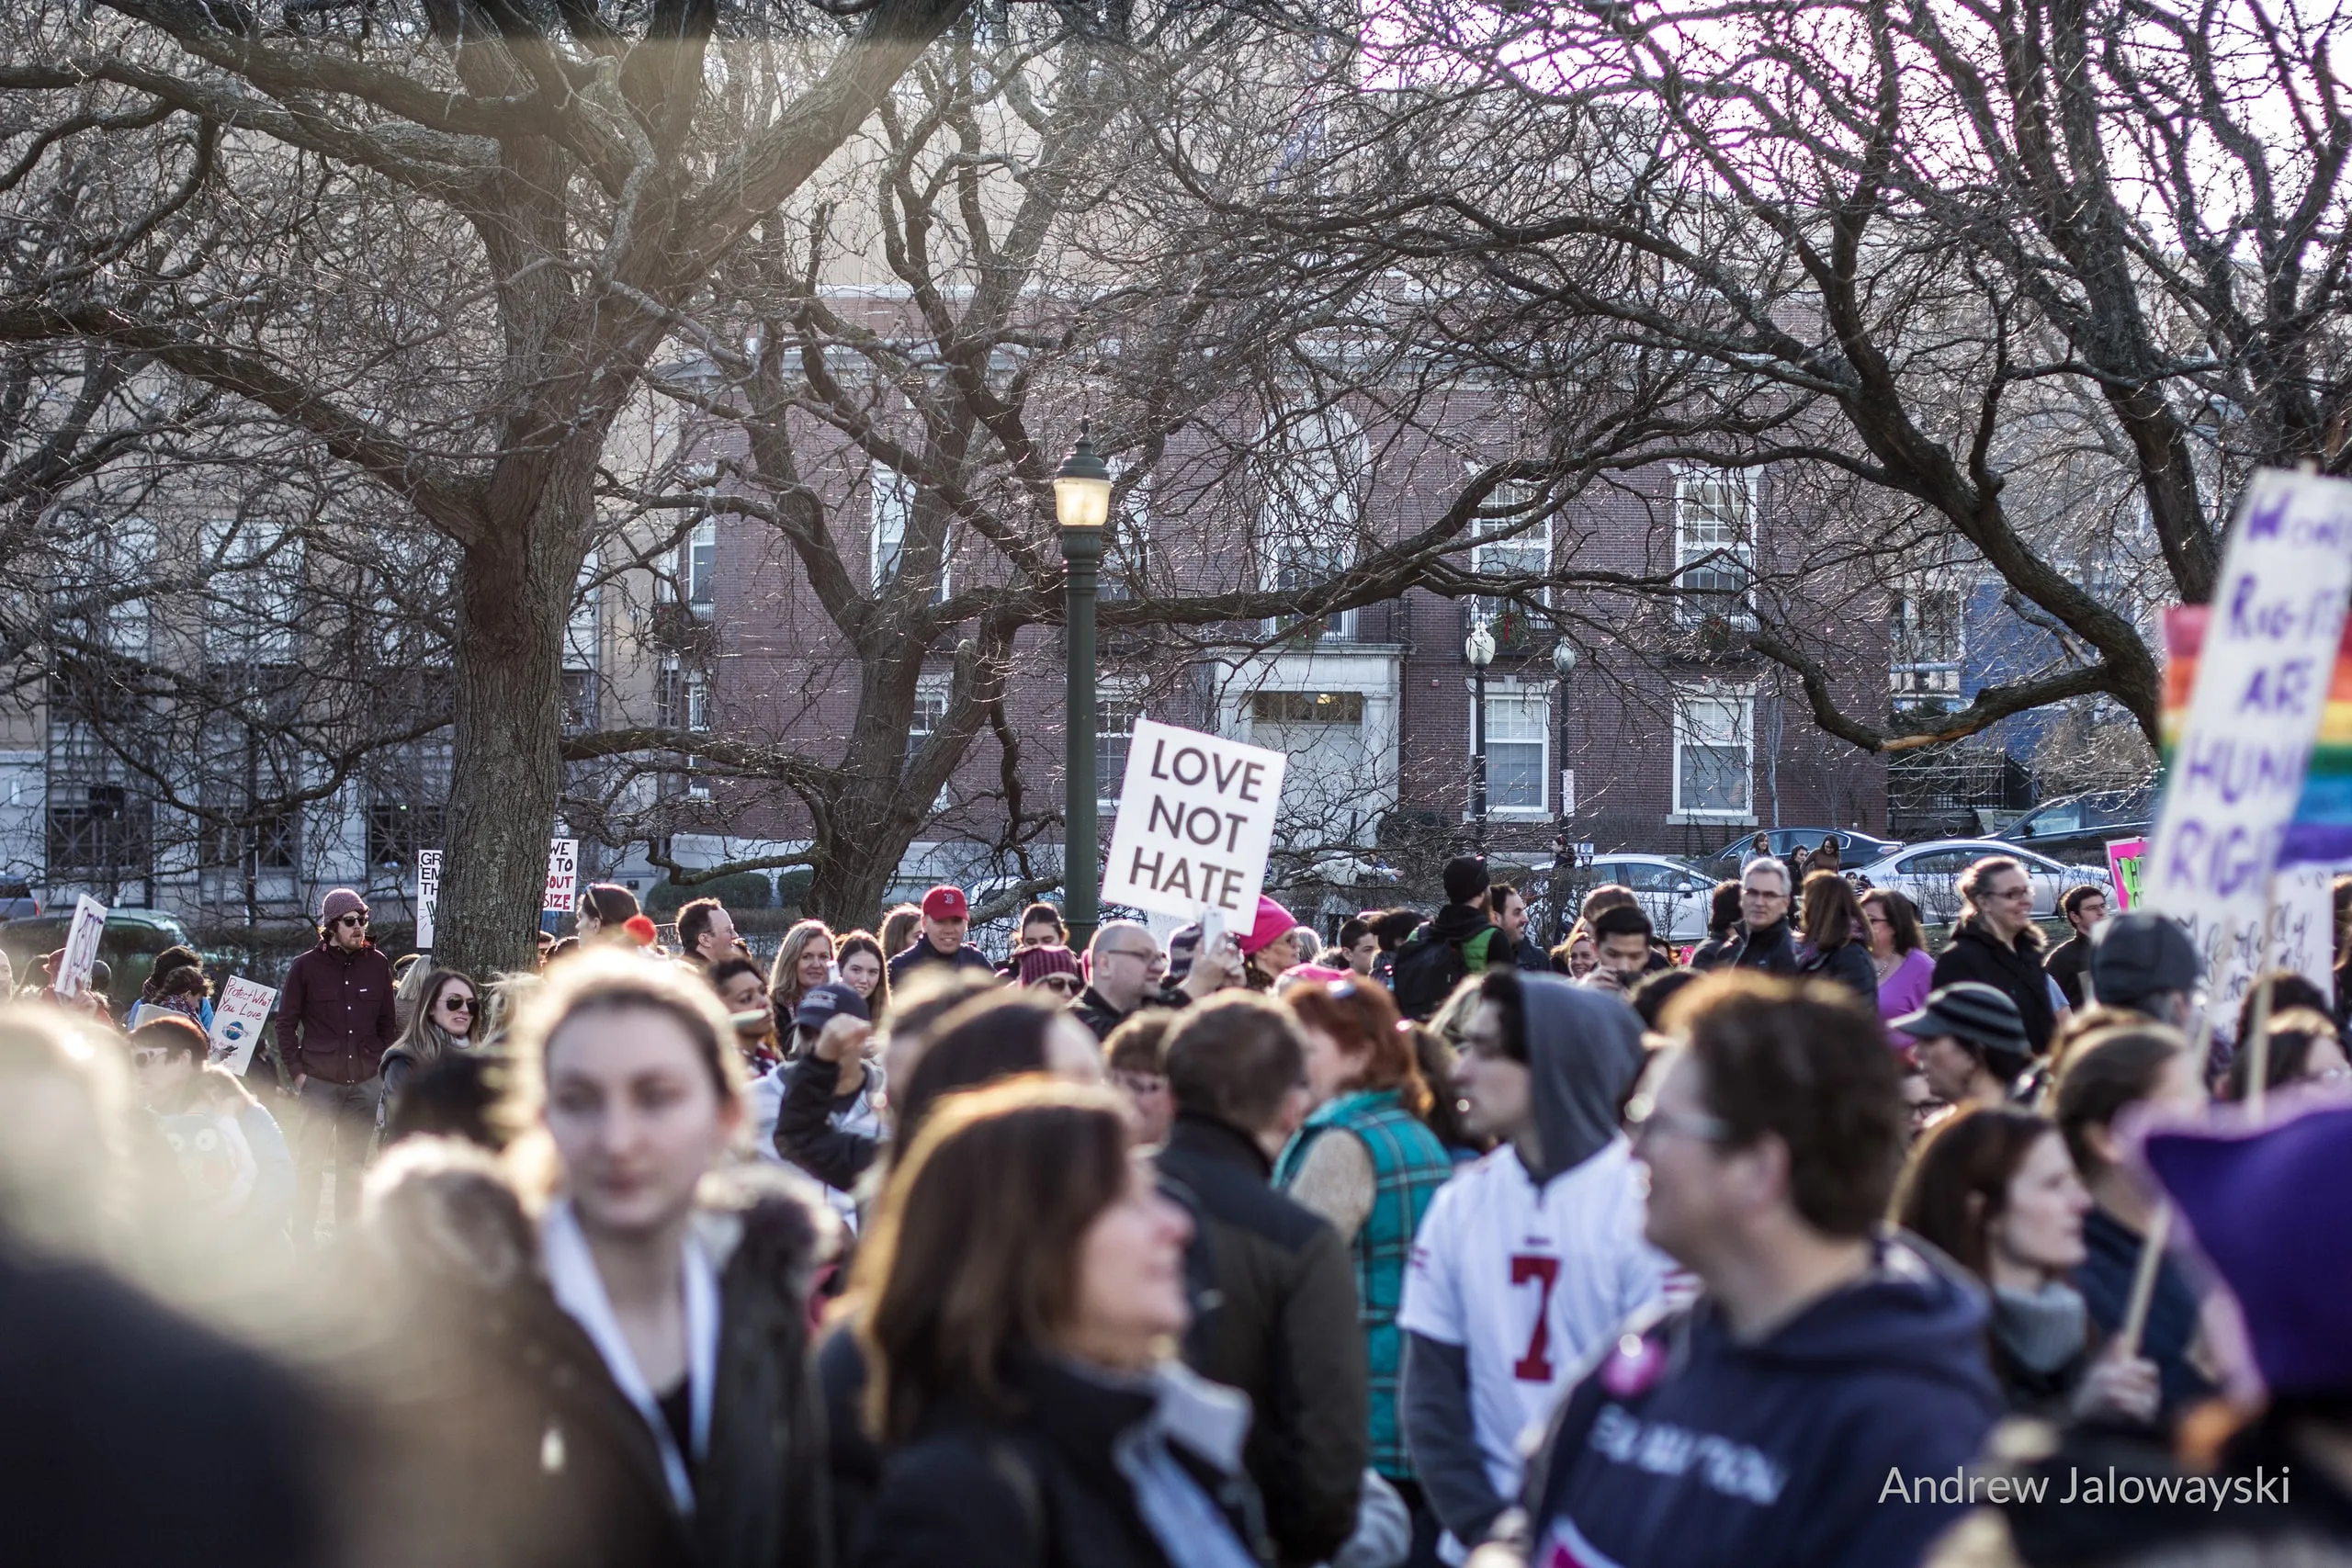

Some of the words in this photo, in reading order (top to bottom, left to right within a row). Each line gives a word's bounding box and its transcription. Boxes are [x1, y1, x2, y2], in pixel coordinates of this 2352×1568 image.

[1150, 739, 1266, 803] LOVE
[1148, 795, 1249, 852] NOT
[556, 858, 573, 873] TO
[1128, 846, 1245, 910] HATE
[543, 894, 571, 910] SIZE
[218, 997, 235, 1012] You
[239, 1003, 262, 1020] Love
[224, 977, 253, 999] Protect
[253, 988, 273, 1007] What
[1510, 1255, 1562, 1384] 7
